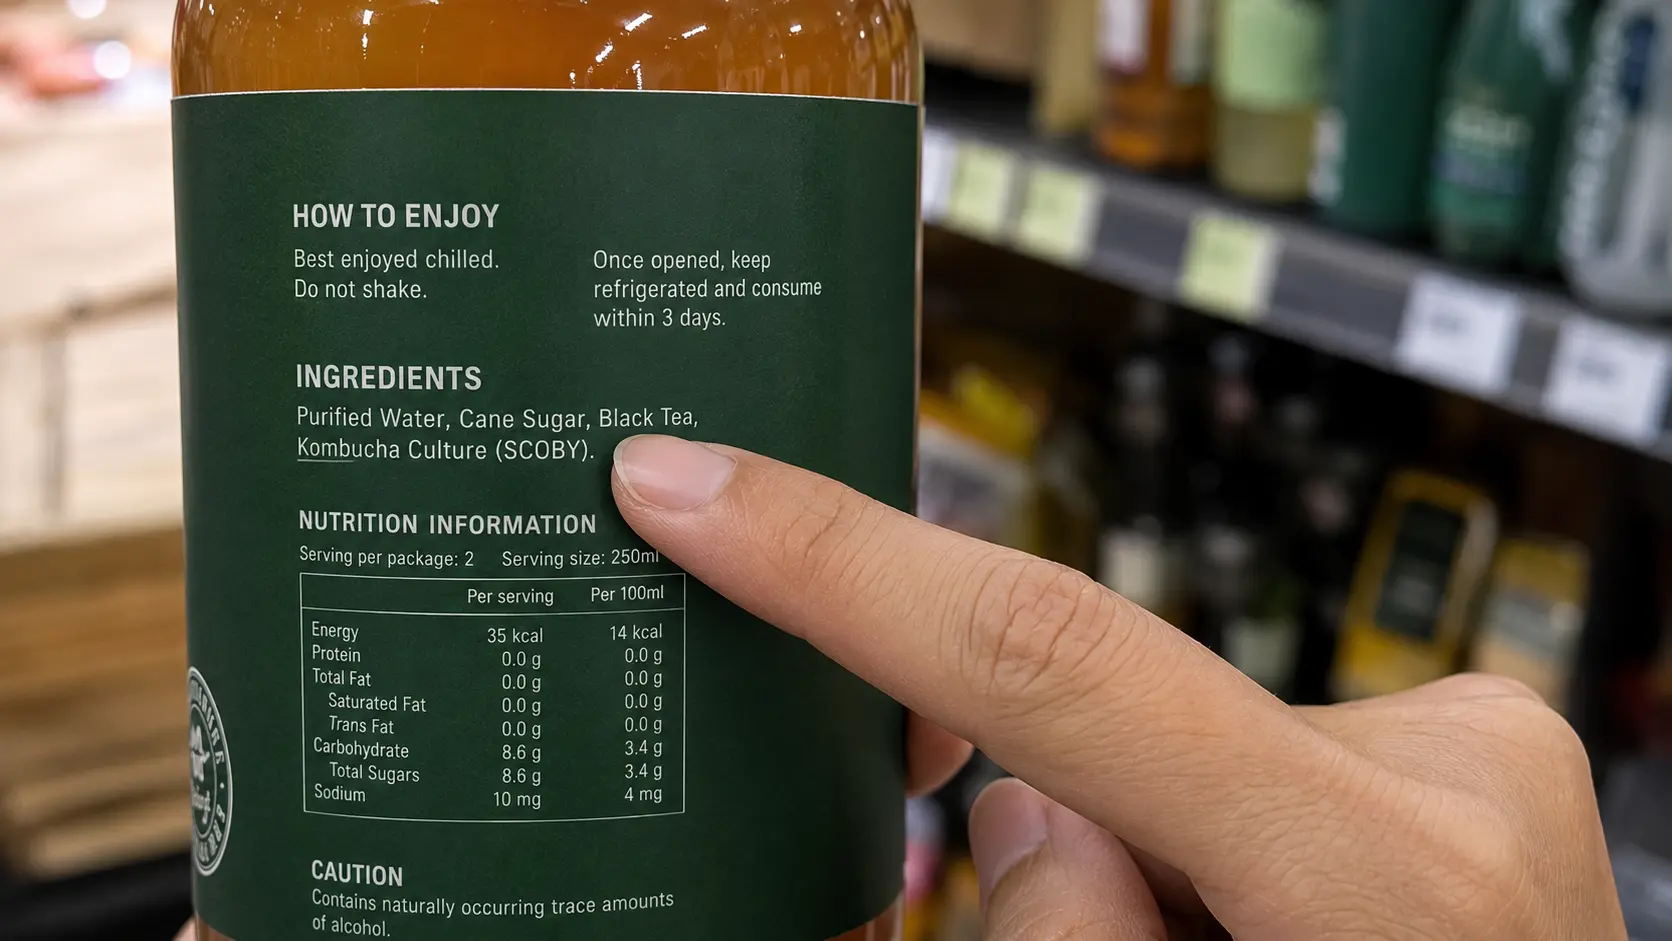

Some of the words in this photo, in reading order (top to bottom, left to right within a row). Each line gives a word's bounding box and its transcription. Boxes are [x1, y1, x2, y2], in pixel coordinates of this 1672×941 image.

[294, 204, 353, 227] HOW
[361, 204, 395, 227] TO
[406, 204, 499, 228] ENJOY
[295, 249, 334, 267] Best
[342, 249, 416, 272] enjoyed
[426, 249, 498, 268] chilled.
[594, 250, 643, 268] Once
[652, 250, 724, 273] opened,
[732, 250, 770, 272] keep
[295, 279, 318, 297] Do
[326, 281, 355, 298] not
[363, 279, 426, 298] shake.
[595, 279, 707, 302] refrigerated
[715, 279, 745, 297] and
[752, 282, 821, 296] consume
[594, 308, 654, 326] within
[663, 308, 672, 326] 3
[681, 308, 725, 330] days.
[297, 364, 481, 390] INGREDIENTS
[298, 406, 371, 426] Purified
[380, 408, 449, 430] Water,
[460, 409, 513, 428] Cane
[523, 409, 590, 432] Sugar,
[600, 408, 653, 427] Black
[661, 408, 697, 427] Tea,
[297, 436, 400, 461] Kombucha
[409, 440, 486, 459] Culture
[496, 439, 593, 462] (SCOBY).
[300, 510, 417, 533] NUTRITION
[430, 515, 595, 534] INFORMATION
[300, 546, 352, 566] Serving
[359, 553, 382, 566] per
[388, 551, 457, 569] package:
[465, 551, 473, 566] 2
[503, 551, 563, 569] Serving
[570, 551, 604, 565] size:
[611, 548, 659, 565] 250ml
[468, 589, 493, 603] Per
[498, 589, 553, 606] serving
[592, 588, 615, 601] Per
[621, 585, 663, 600] 100ml
[312, 621, 358, 642] Energy
[488, 628, 506, 643] 35
[513, 628, 542, 643] kcal
[611, 626, 627, 640] 14
[633, 623, 661, 639] kcal
[313, 644, 360, 662] Protein
[503, 651, 526, 666] 0.0
[532, 655, 540, 669] g
[625, 648, 647, 662] 0.0
[654, 651, 661, 664] g
[313, 668, 344, 684] Total
[350, 671, 371, 686] Fat
[503, 674, 526, 689] 0.0
[532, 678, 540, 692] g
[625, 670, 647, 685] 0.0
[654, 673, 662, 687] g
[329, 692, 397, 710] Saturated
[404, 697, 426, 712] Fat
[503, 698, 525, 712] 0.0
[532, 702, 540, 716] g
[625, 694, 647, 708] 0.0
[654, 696, 662, 711] g
[329, 716, 366, 732] Trans
[372, 719, 393, 734] Fat
[503, 721, 526, 736] 0.0
[532, 725, 540, 739] g
[625, 717, 647, 732] 0.0
[654, 720, 661, 734] g
[314, 737, 408, 759] Carbohydrate
[503, 745, 525, 759] 8.6
[532, 748, 540, 763] g
[625, 740, 647, 755] 3.4
[654, 743, 662, 757] g
[330, 762, 362, 778] Total
[369, 765, 419, 784] Sugars
[503, 768, 526, 783] 8.6
[532, 772, 540, 786] g
[625, 763, 647, 778] 3.4
[654, 766, 661, 780] g
[315, 784, 365, 801] Sodium
[494, 792, 510, 806] 10
[518, 795, 540, 809] mg
[625, 787, 633, 801] 4
[640, 789, 661, 803] mg
[312, 860, 402, 886] CAUTION
[313, 889, 376, 910] Contains
[383, 899, 454, 918] naturally
[462, 900, 543, 918] occurring
[552, 900, 595, 914] trace
[603, 893, 673, 911] amounts
[313, 915, 326, 930] of
[332, 917, 390, 936] alcohol.
